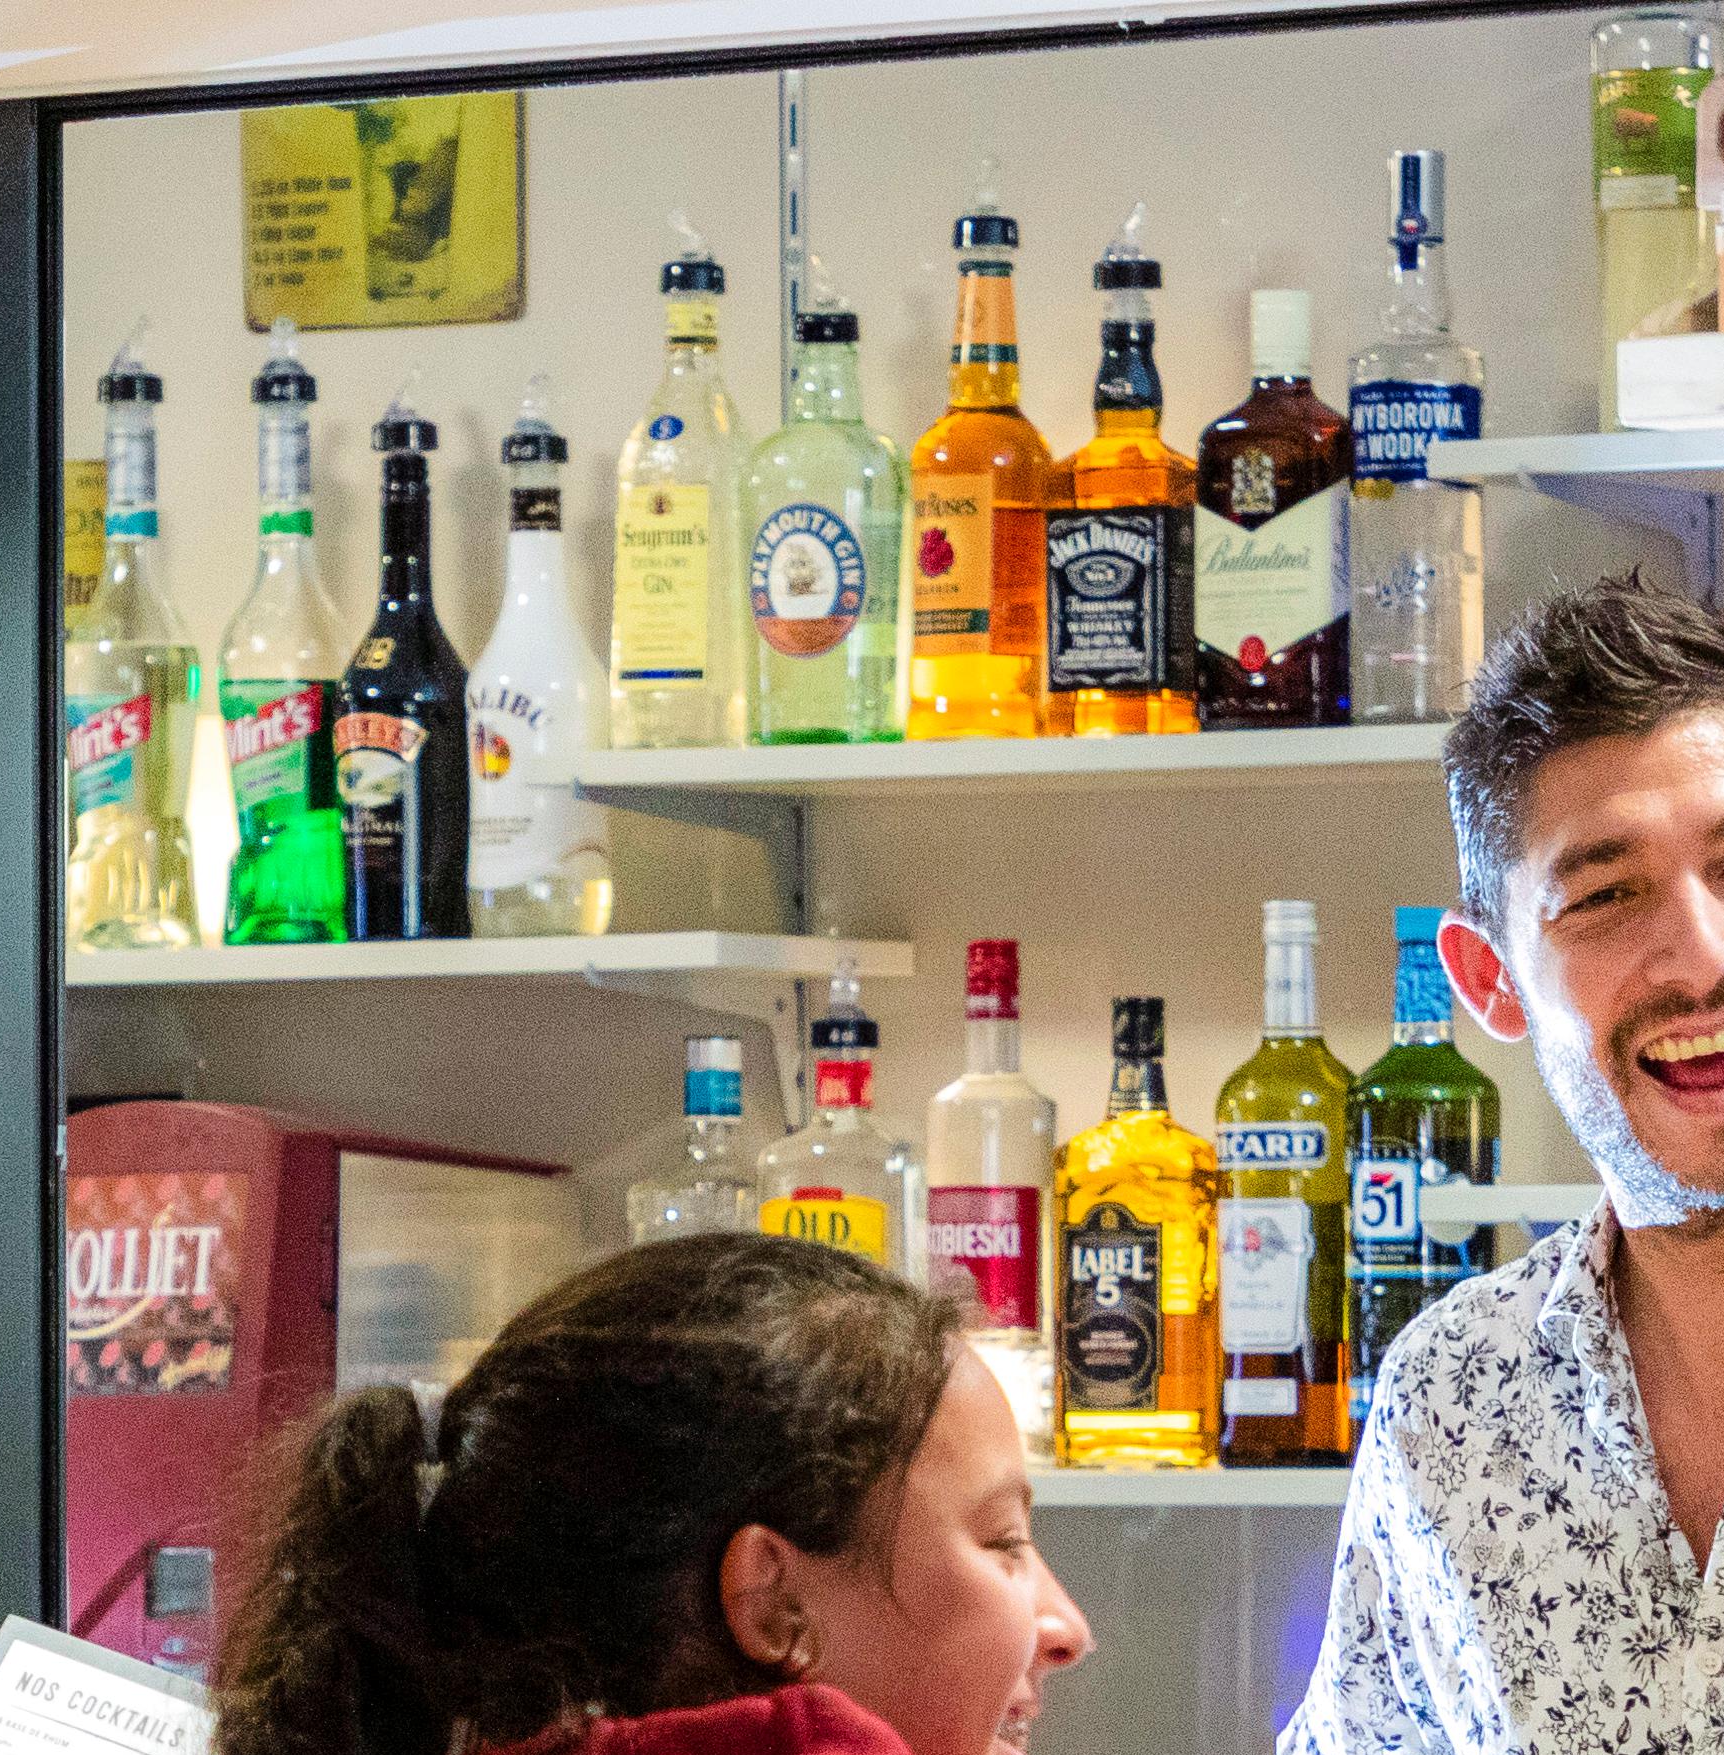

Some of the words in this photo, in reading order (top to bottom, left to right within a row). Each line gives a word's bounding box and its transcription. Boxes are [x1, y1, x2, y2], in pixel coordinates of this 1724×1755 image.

[1352, 403, 1465, 431] WYBOROWA
[752, 510, 841, 587] PLYMOUTH
[1218, 1133, 1319, 1158] ICARD
[1362, 1180, 1404, 1228] 51
[928, 1223, 1021, 1258] OBIESKI
[66, 1223, 221, 1300] OLLIET
[1072, 1245, 1149, 1281] LABEL
[1095, 1276, 1122, 1307] 5
[15, 1671, 60, 1702] NOS
[67, 1690, 185, 1748] COCKTAILS
